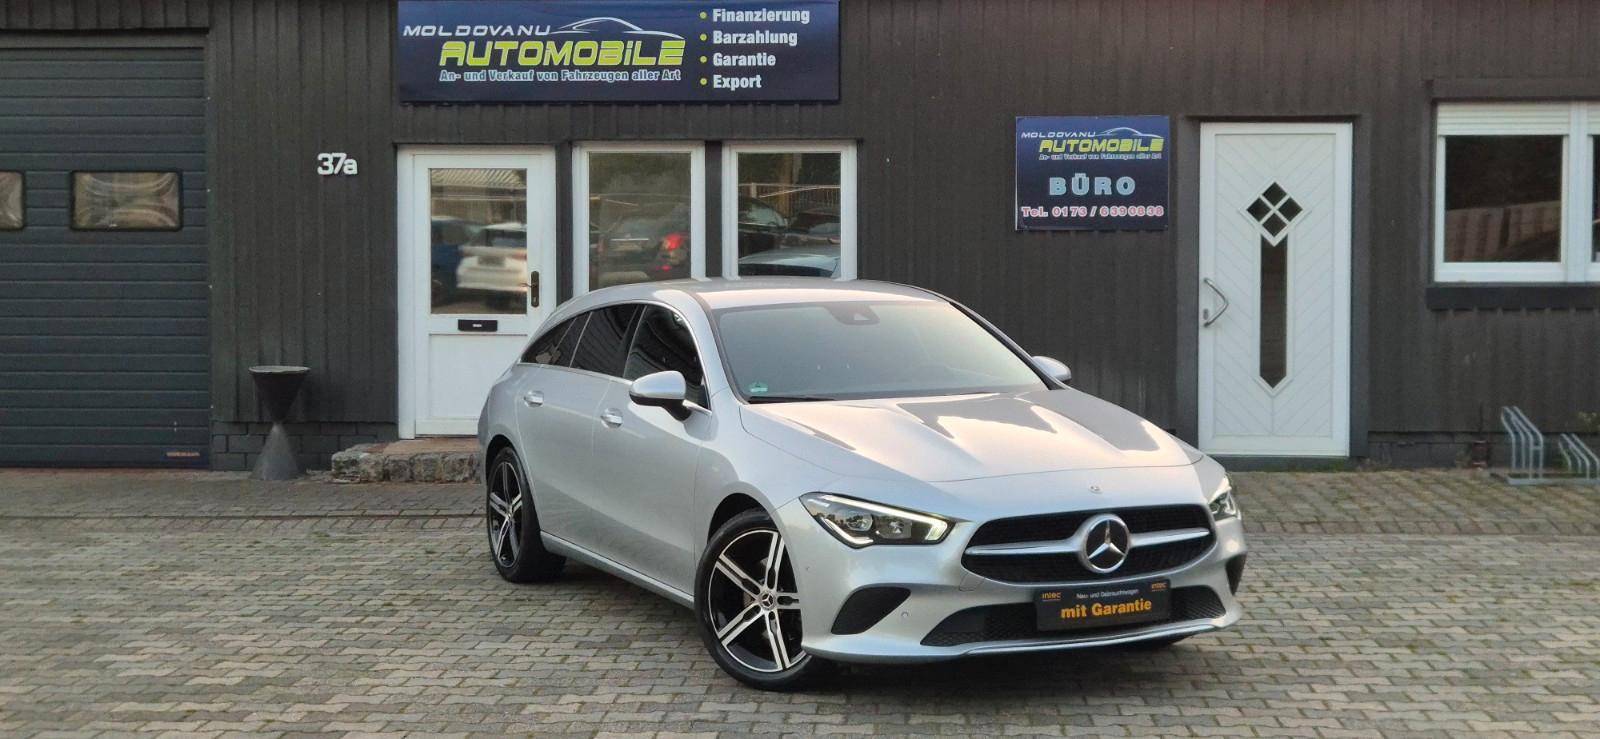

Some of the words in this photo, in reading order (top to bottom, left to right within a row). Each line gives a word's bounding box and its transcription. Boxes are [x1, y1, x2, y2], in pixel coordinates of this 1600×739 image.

[713, 8, 810, 24] Finanzierung
[403, 25, 550, 36] MOLDOVANU
[713, 30, 798, 47] Barzahlung
[439, 40, 686, 66] AUTOMOBILE
[713, 52, 776, 66] Garantie
[439, 69, 461, 81] An-
[464, 69, 486, 81] und
[488, 69, 534, 81] Verkauf
[537, 70, 558, 81] von
[561, 69, 629, 83] Fahrzeugen
[632, 69, 660, 81] aller
[662, 69, 681, 81] Art
[713, 74, 762, 91] Export
[1039, 138, 1164, 153] AUTOMOBILE
[317, 152, 358, 175] 37a
[1049, 173, 1136, 195] BÜRO
[1021, 206, 1048, 217] Tel.
[1052, 206, 1087, 217] 0173
[1061, 604, 1087, 618] mit
[1091, 598, 1152, 616] Garantie
